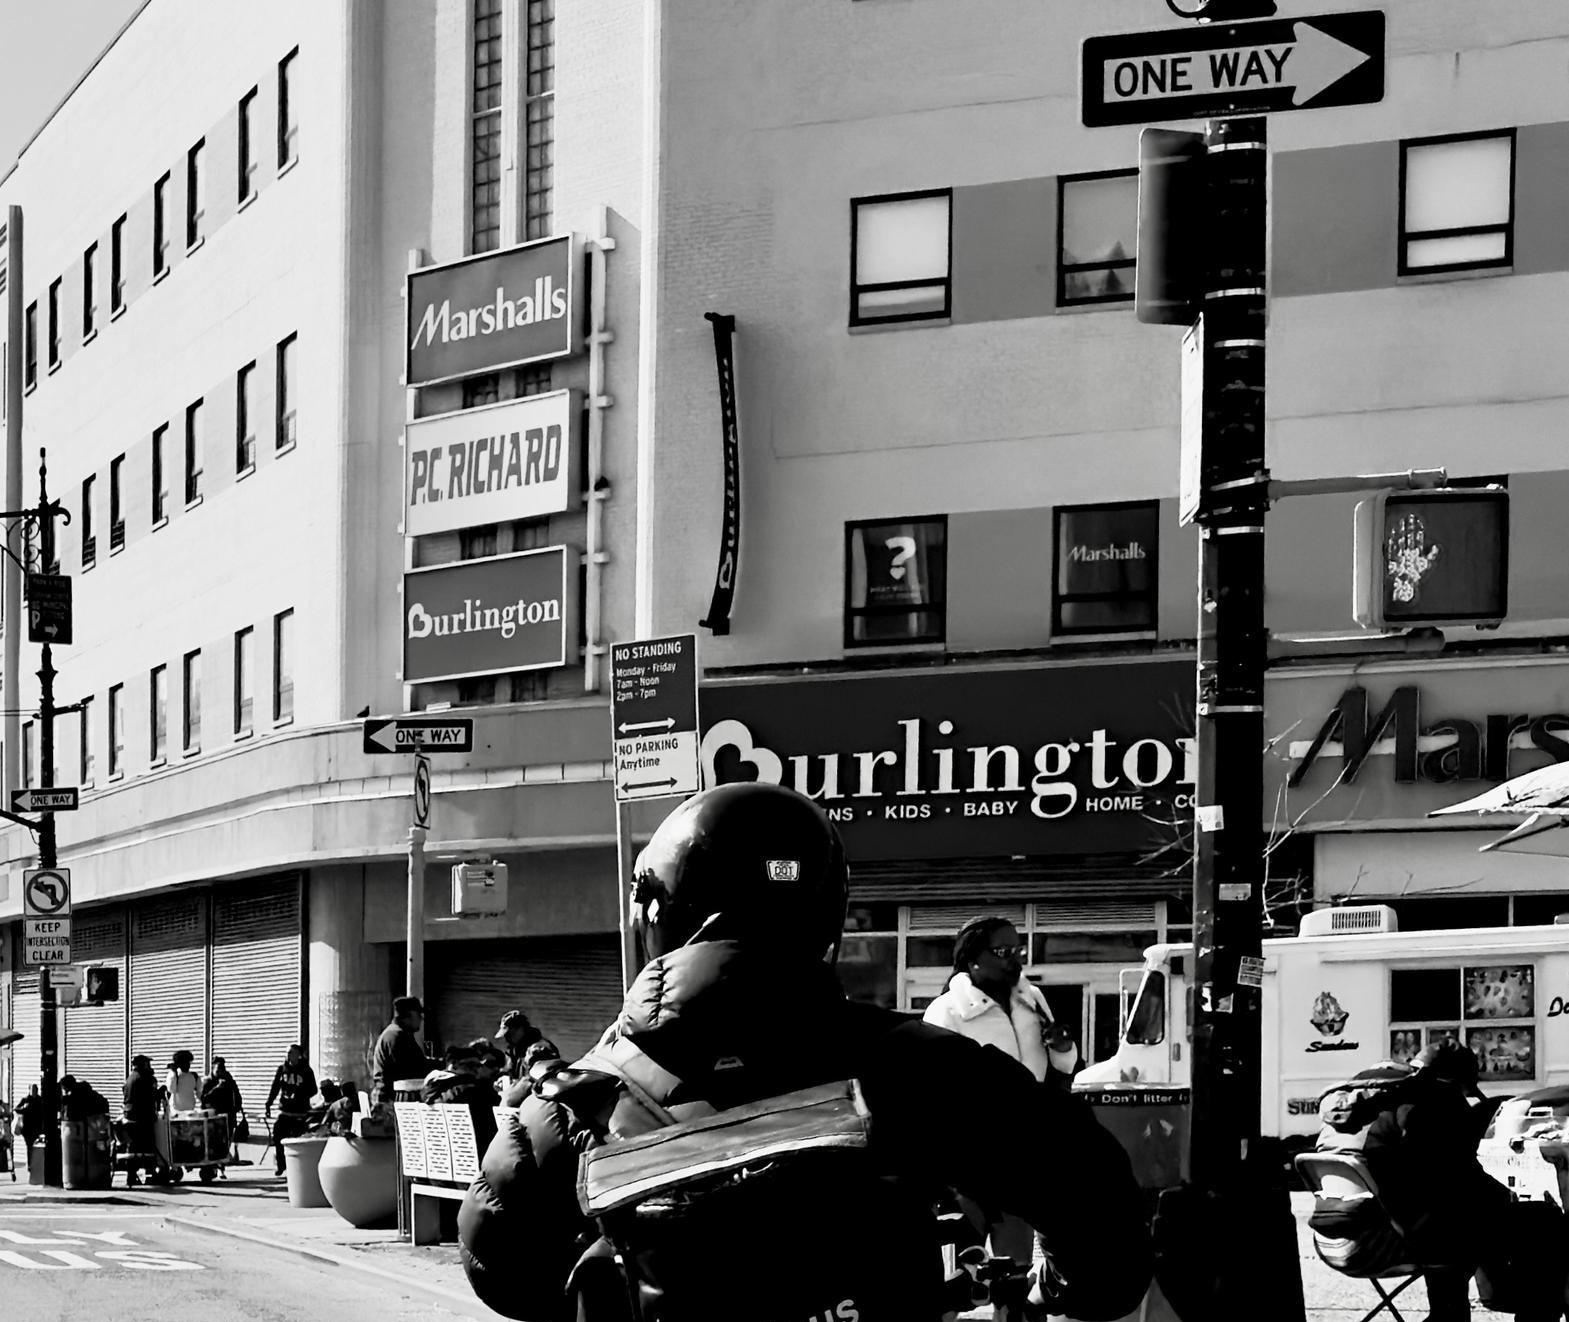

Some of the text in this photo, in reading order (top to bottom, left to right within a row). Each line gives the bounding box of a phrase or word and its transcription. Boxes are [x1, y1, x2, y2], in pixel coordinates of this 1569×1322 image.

[1114, 47, 1293, 97] ONE WAY
[411, 275, 567, 350] Marshalls
[410, 424, 562, 506] P.C. RICHARD
[1069, 542, 1146, 562] Marshalls
[408, 599, 560, 639] Burlington
[616, 641, 682, 661] NO STANDING
[616, 666, 645, 677] Monday
[653, 662, 676, 673] Friday
[617, 679, 633, 689] 7am
[640, 676, 659, 686] Noon
[616, 691, 633, 702] 2pm
[640, 688, 656, 699] 7pm
[396, 729, 461, 744] ONE WAY
[619, 738, 679, 755] NO PARKING
[620, 756, 661, 771] Anytime
[699, 718, 1198, 819] Burlingto
[31, 794, 72, 806] ONE WAY
[1086, 796, 1143, 811] HOME
[885, 804, 931, 819] KIDS
[964, 801, 1018, 816] BABY
[35, 922, 61, 933] KEEP
[32, 950, 64, 961] CLEAR
[1101, 1094, 1172, 1103] Don't litter
